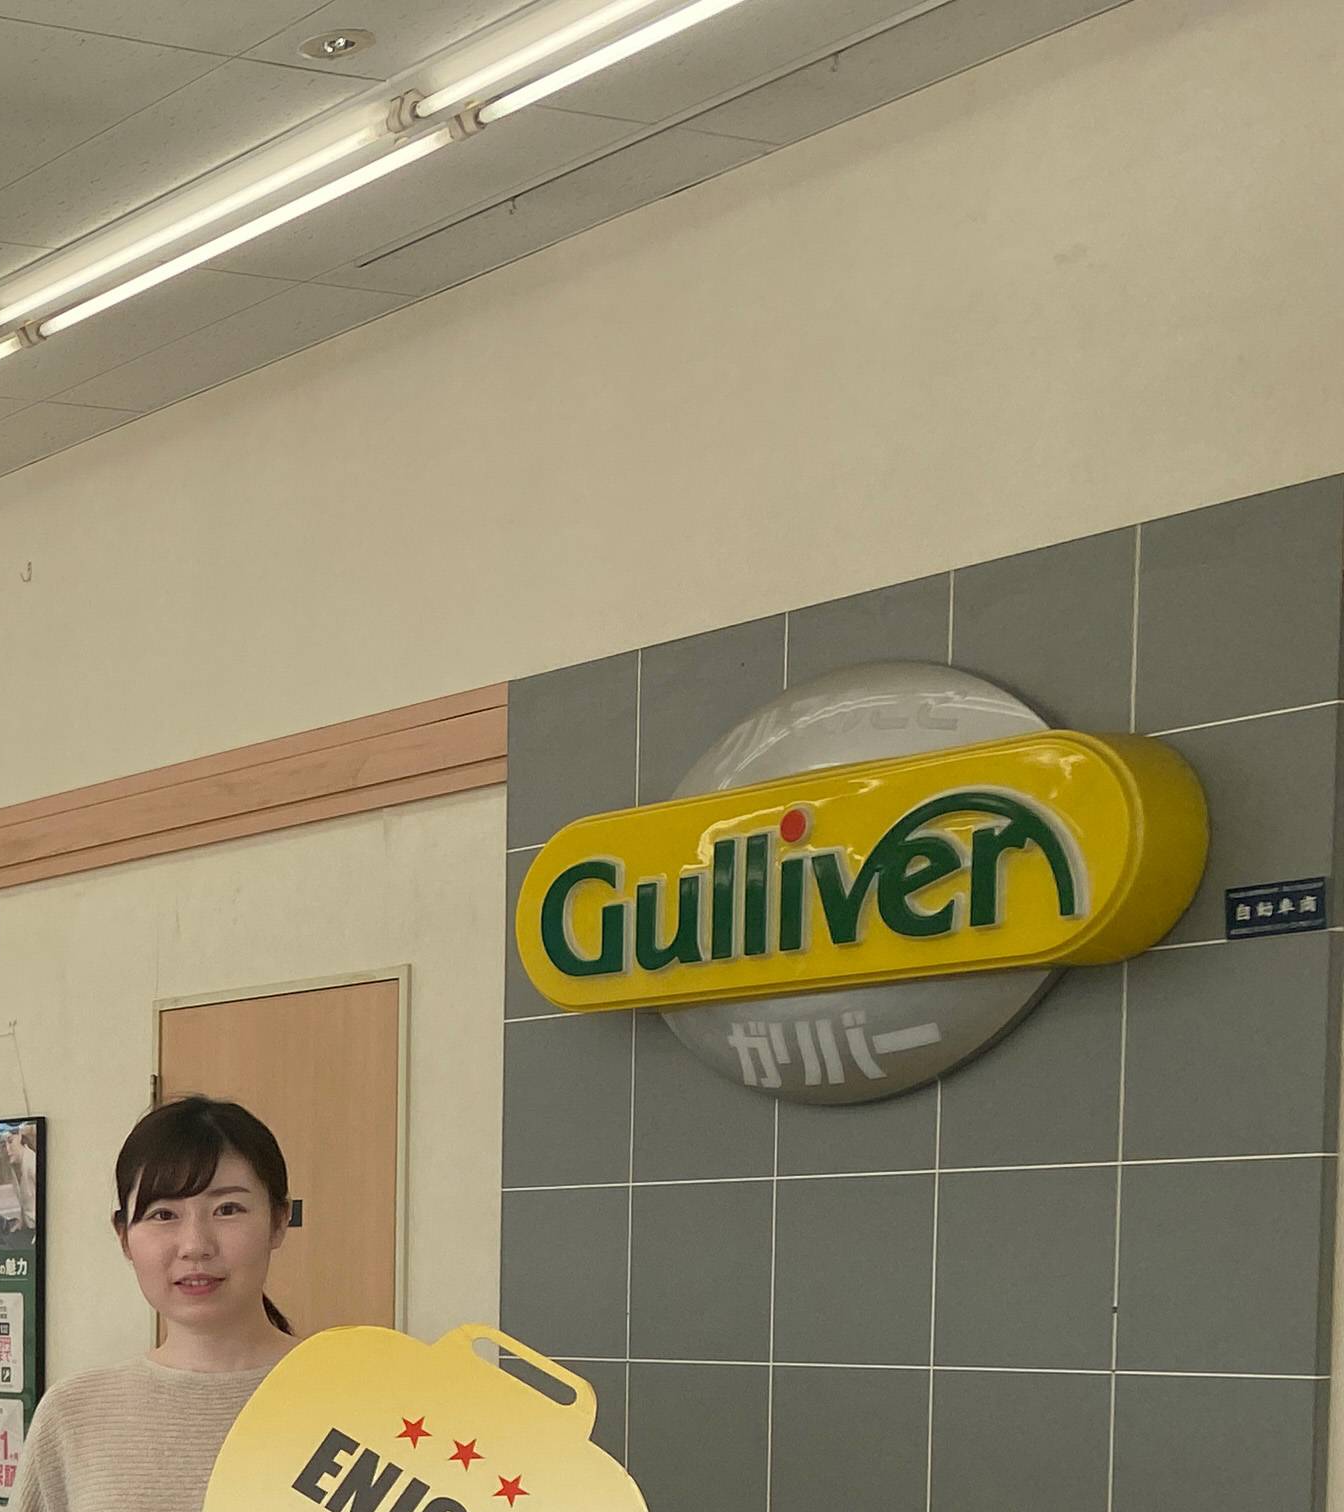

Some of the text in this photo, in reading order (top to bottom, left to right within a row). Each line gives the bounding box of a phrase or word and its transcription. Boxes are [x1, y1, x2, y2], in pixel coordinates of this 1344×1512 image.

[540, 788, 1082, 977] Gulliver
[728, 1011, 942, 1088] ガリバー
